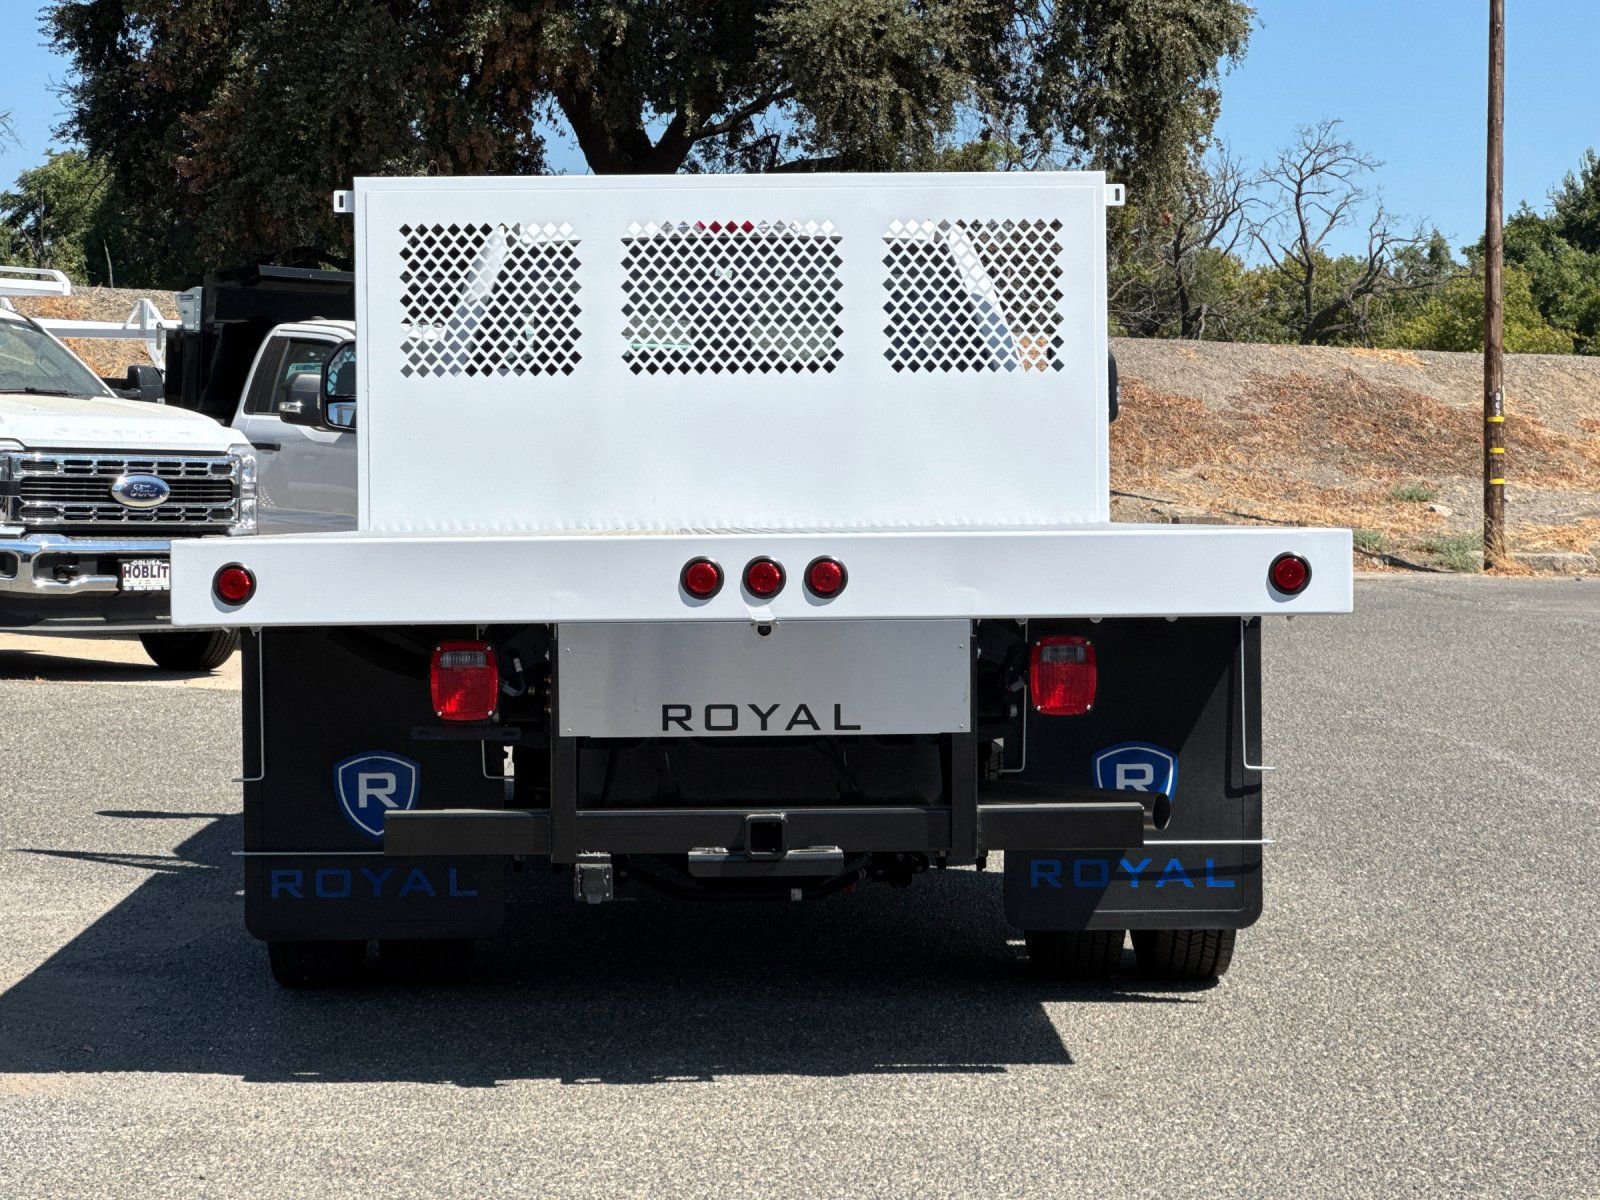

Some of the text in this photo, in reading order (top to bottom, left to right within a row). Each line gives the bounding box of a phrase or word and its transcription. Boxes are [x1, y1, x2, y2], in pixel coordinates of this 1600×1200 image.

[130, 483, 158, 498] Ford
[122, 565, 169, 579] HOBLIT
[662, 703, 861, 732] ROYAL
[357, 772, 400, 808] R
[270, 867, 479, 899] ROYAL
[1029, 856, 1236, 889] ROYAL
